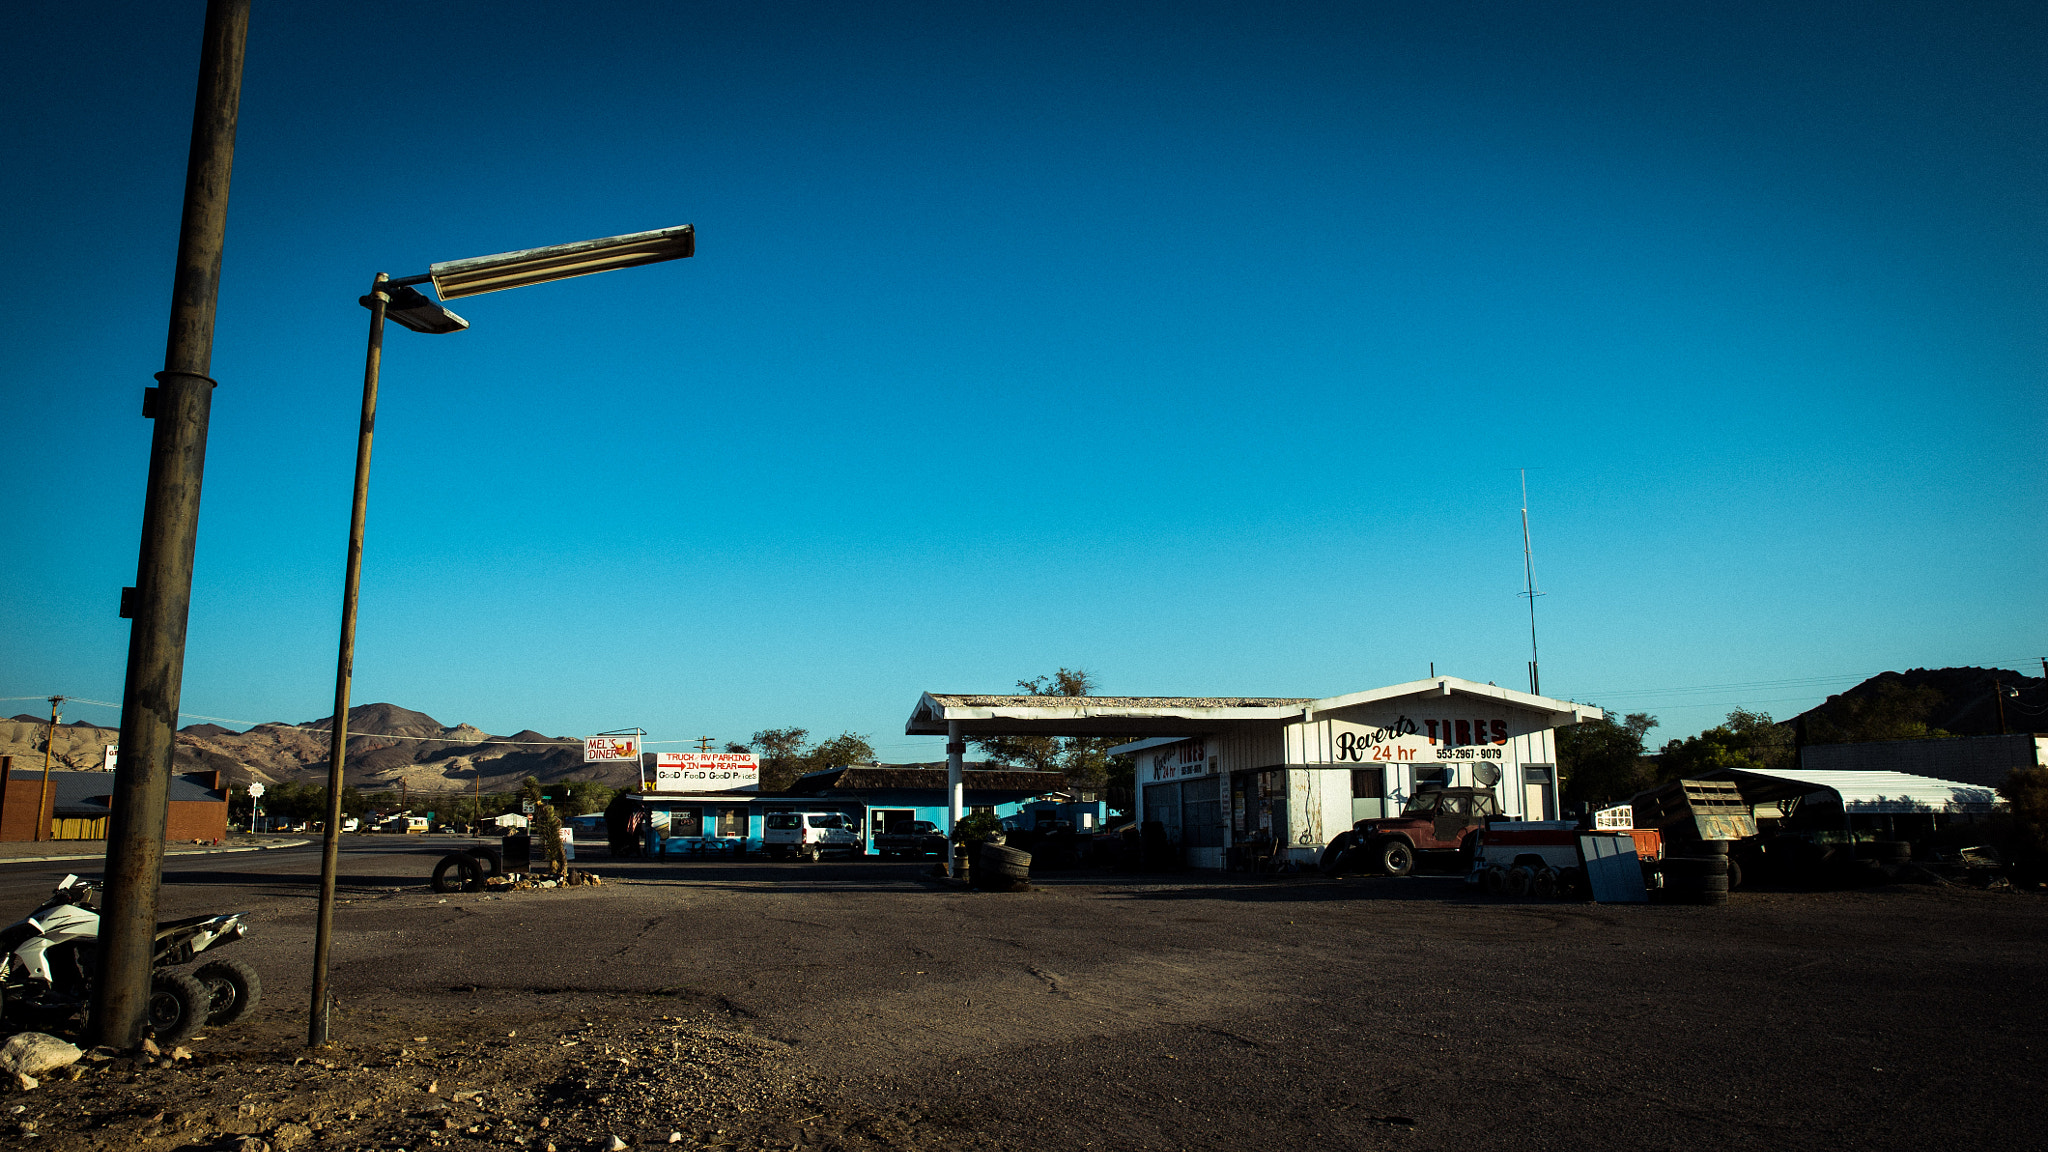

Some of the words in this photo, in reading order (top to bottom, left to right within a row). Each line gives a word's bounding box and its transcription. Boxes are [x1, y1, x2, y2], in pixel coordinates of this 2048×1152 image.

[588, 739, 617, 749] MEL'S
[1336, 715, 1420, 762] Reverts
[1424, 719, 1508, 746] TIRES
[588, 749, 617, 759] DINER
[666, 753, 695, 761] TRUCK
[700, 753, 711, 761] RV
[712, 754, 751, 762] PARKING
[1178, 739, 1205, 765] TIRES
[1372, 745, 1392, 761] 24
[1398, 745, 1417, 761] hr
[686, 762, 700, 770] IN
[716, 762, 737, 770] REAR
[1162, 766, 1169, 779] 24
